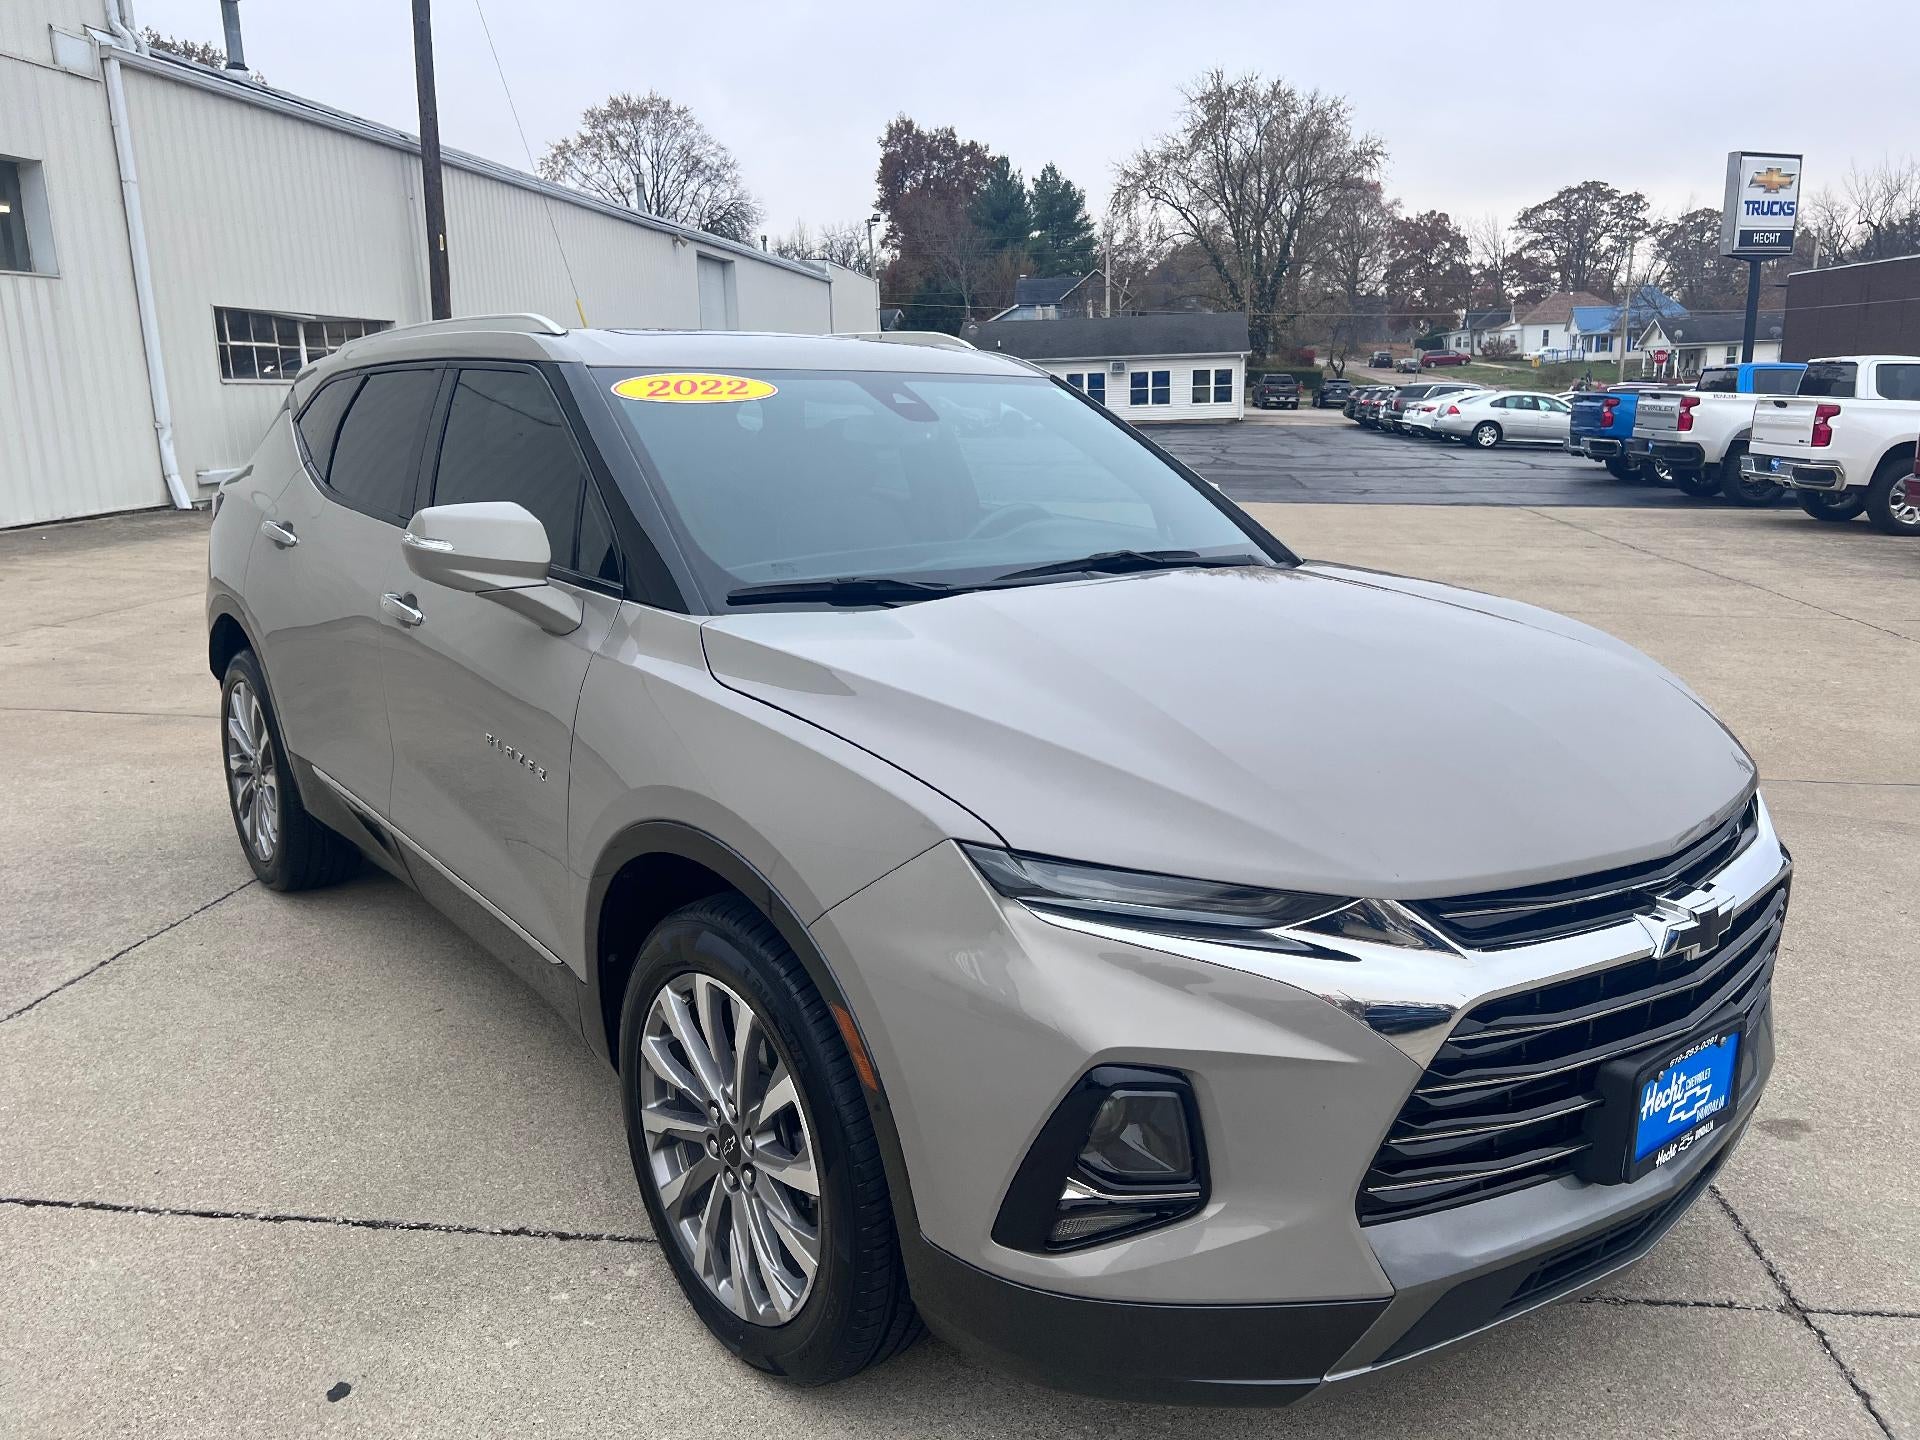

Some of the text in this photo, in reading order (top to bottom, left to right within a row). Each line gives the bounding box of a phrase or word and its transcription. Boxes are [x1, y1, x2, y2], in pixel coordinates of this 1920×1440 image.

[1744, 200, 1795, 216] TRUCKS
[1753, 232, 1781, 243] HECHT
[1654, 353, 1668, 361] STOP
[646, 379, 749, 397] 2022
[1640, 1071, 1687, 1122] Hecht
